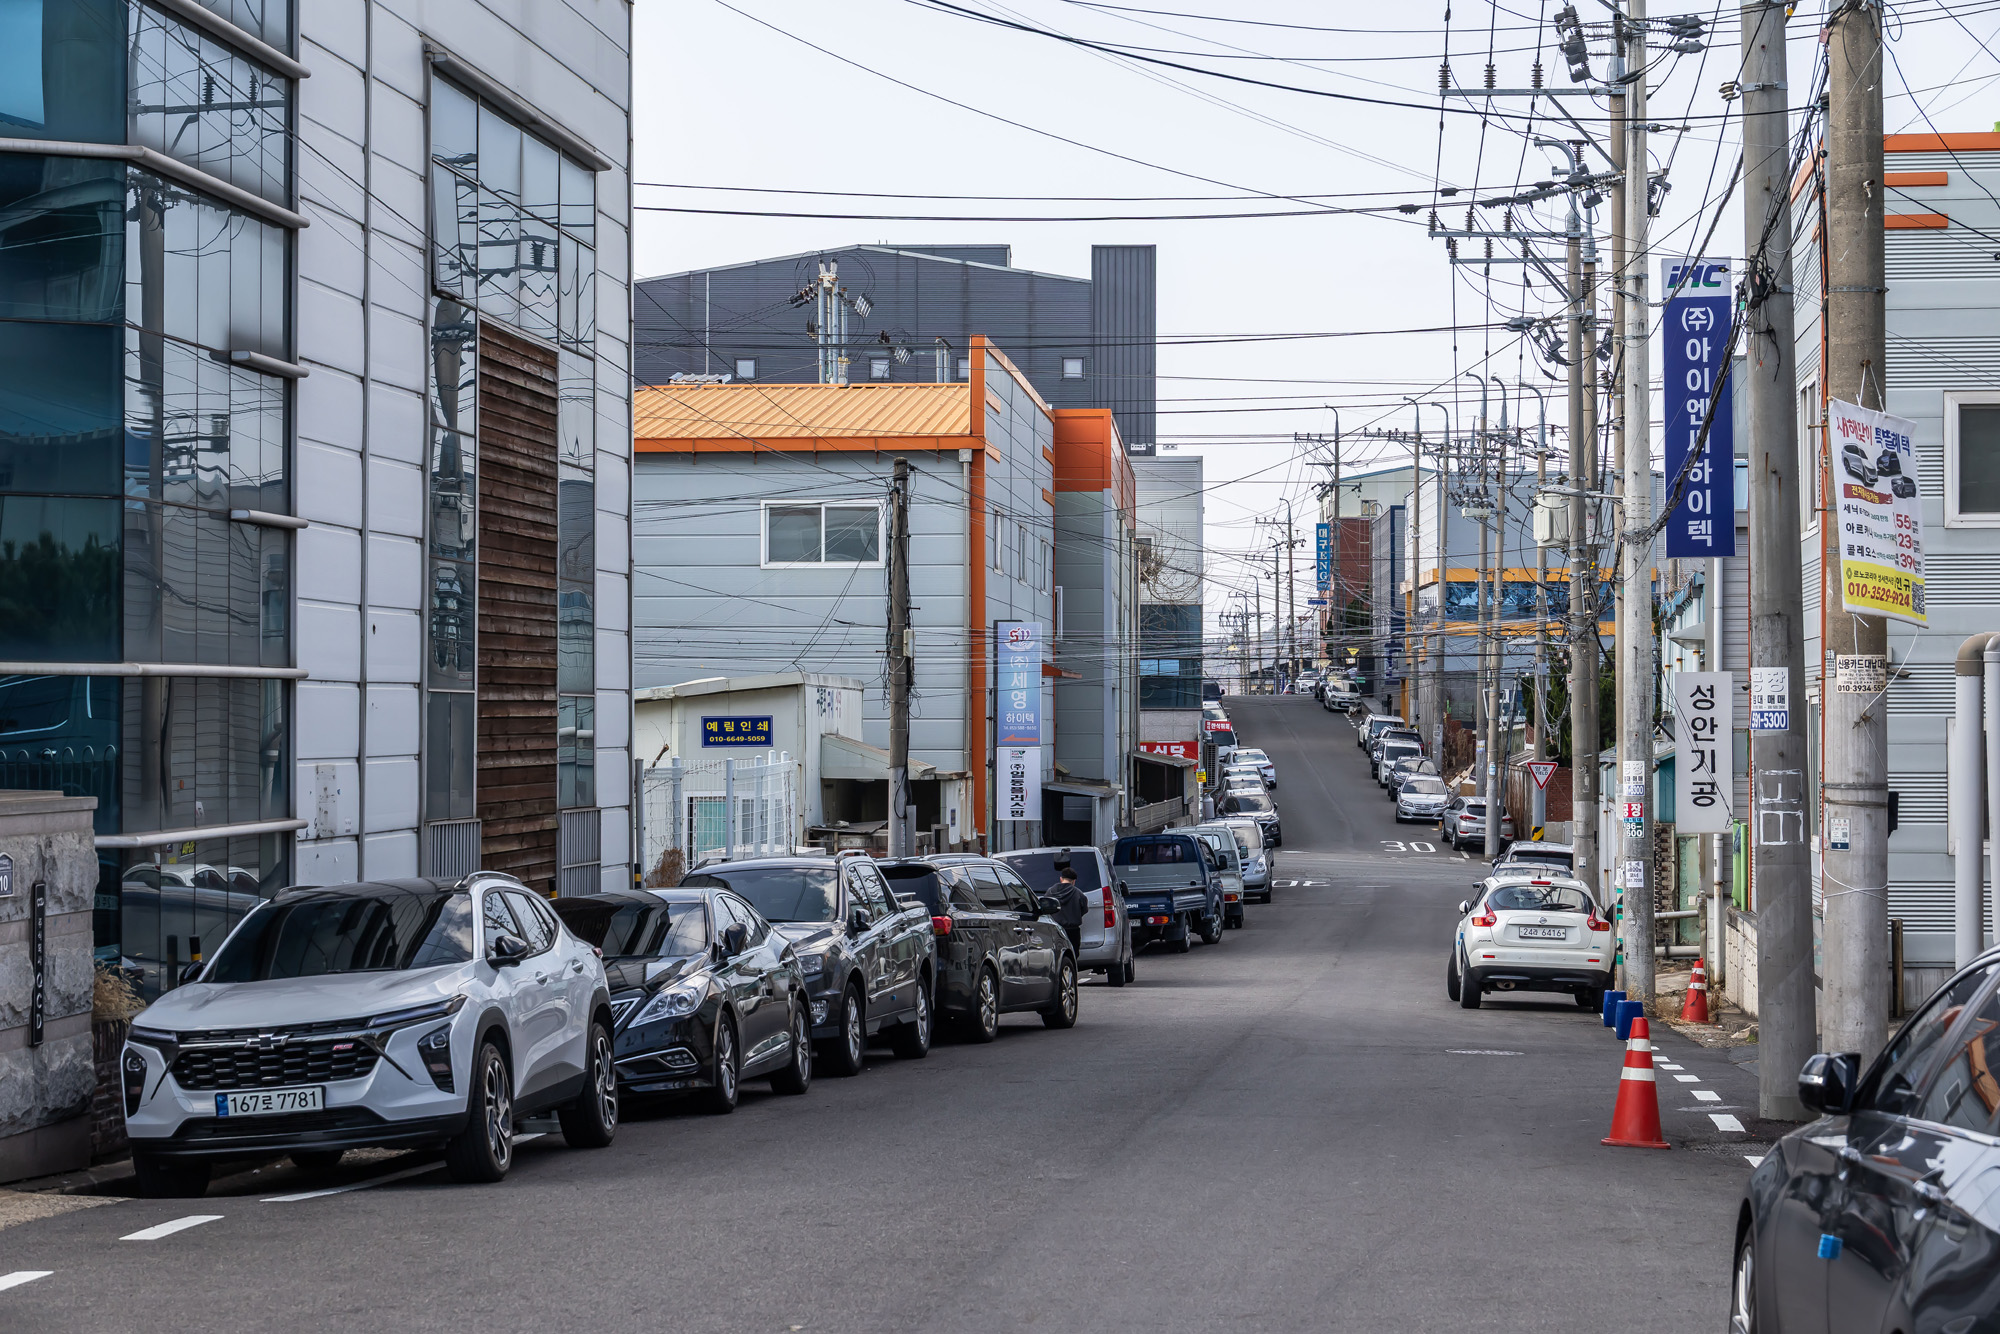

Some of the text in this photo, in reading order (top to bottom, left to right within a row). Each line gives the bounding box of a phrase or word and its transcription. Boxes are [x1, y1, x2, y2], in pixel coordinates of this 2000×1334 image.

[1836, 416, 1911, 457] 새해맞이 특별혜택
[1843, 503, 1859, 515] 세닉
[1318, 528, 1328, 581] 대구ENG
[1846, 543, 1876, 560] 콜레오스
[706, 720, 769, 732] 예림인쇄
[1006, 712, 1035, 724] 하이텍
[1751, 712, 1786, 728] 591-5300
[1689, 684, 1718, 807] 성안기공
[1380, 840, 1437, 853] 30
[1541, 928, 1561, 937] 6416
[230, 1090, 316, 1113] 167로 7781
